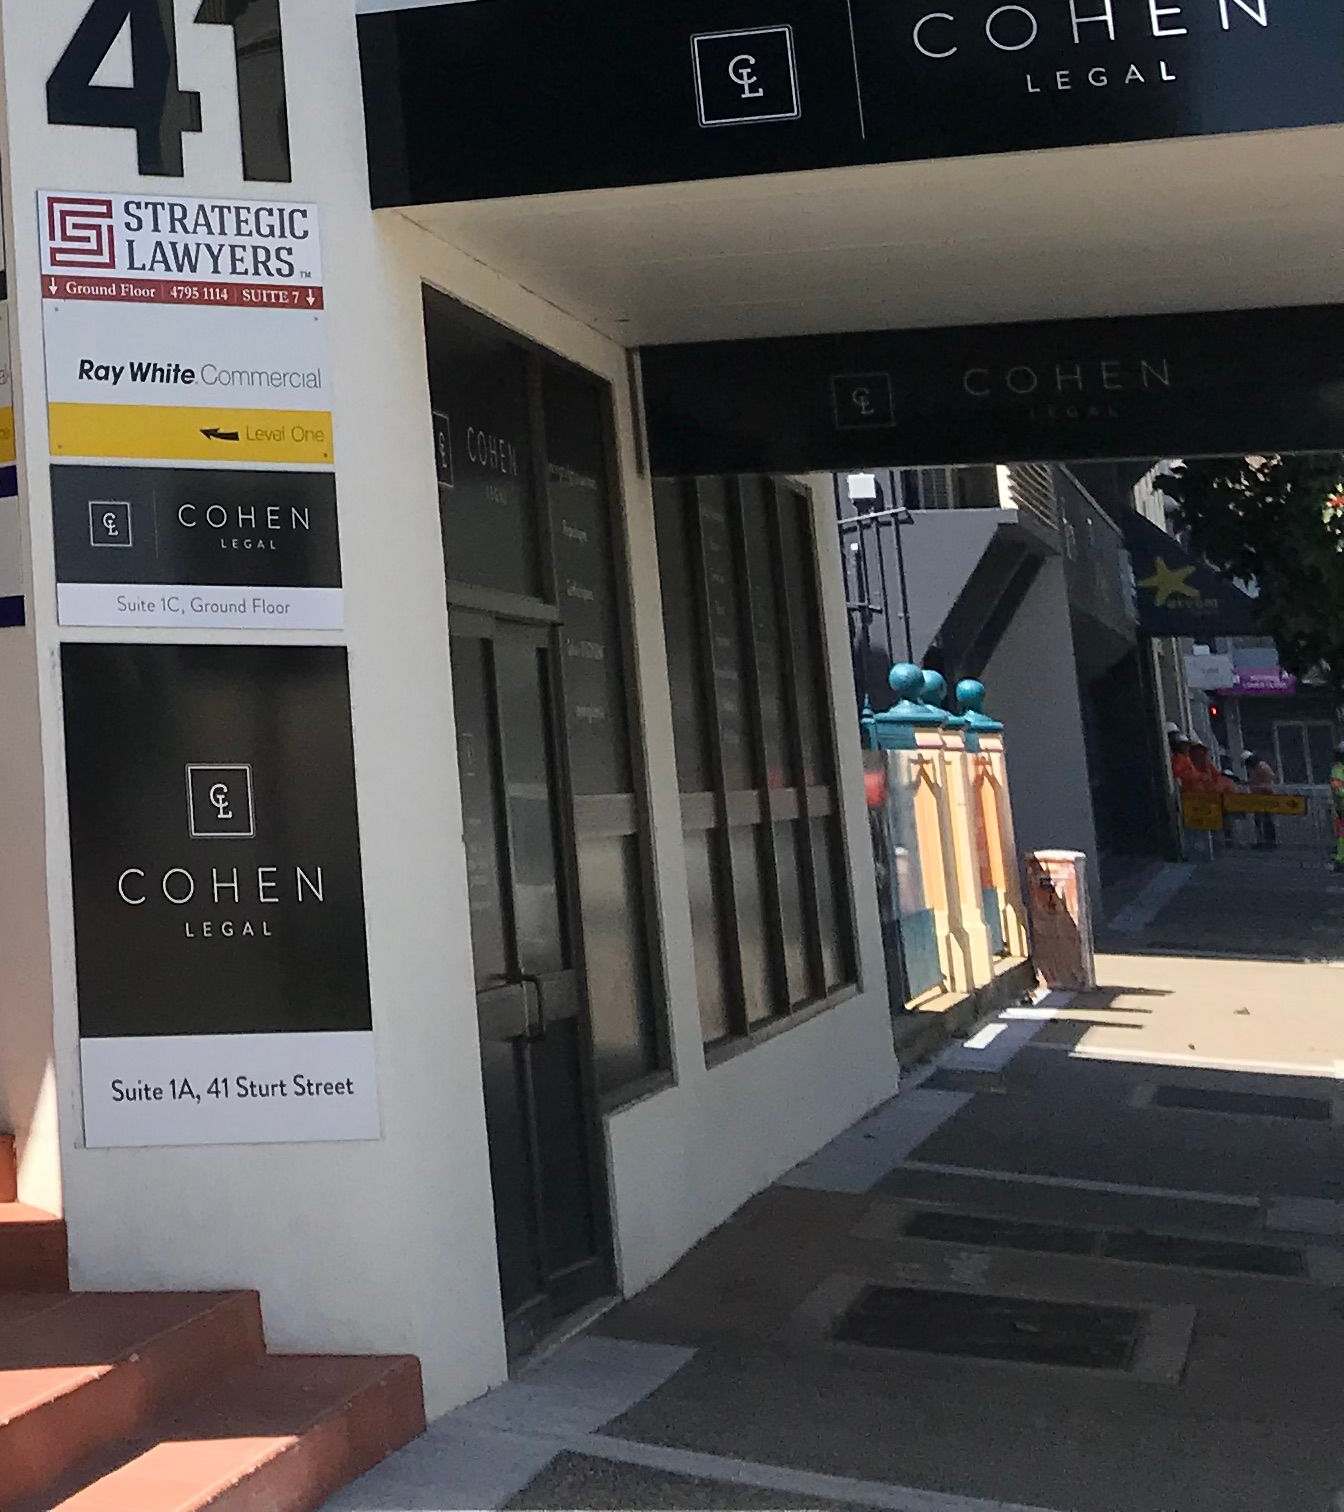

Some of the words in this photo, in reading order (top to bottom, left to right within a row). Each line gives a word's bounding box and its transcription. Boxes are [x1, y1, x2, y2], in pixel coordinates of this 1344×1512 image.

[1026, 60, 1177, 93] LEGAL
[124, 200, 309, 240] STRATEGIC
[125, 239, 295, 278] LAWYERS
[65, 281, 117, 296] Ground
[120, 283, 155, 298] Floor
[170, 286, 199, 300] 4795
[203, 287, 228, 300] 1114
[242, 289, 289, 304] SUITE
[292, 291, 300, 304] 7
[78, 359, 125, 386] Ray
[129, 361, 195, 385] White
[201, 363, 322, 388] Commercial
[963, 359, 1172, 397] COHEN
[246, 425, 285, 442] Level
[291, 426, 325, 443] One
[467, 427, 517, 476] COHEN
[178, 503, 311, 530] COHEN
[220, 539, 276, 551] LEGAL
[116, 596, 155, 613] Suite
[161, 596, 186, 615] 1C,
[190, 597, 246, 614] Ground
[252, 598, 291, 615] Floor
[118, 865, 324, 905] COHEN
[185, 920, 272, 938] LEGAL
[111, 1078, 163, 1102] Suite
[169, 1078, 201, 1104] 1A,
[206, 1077, 230, 1099] 41
[236, 1076, 288, 1098] Sturt
[293, 1074, 355, 1097] Street
